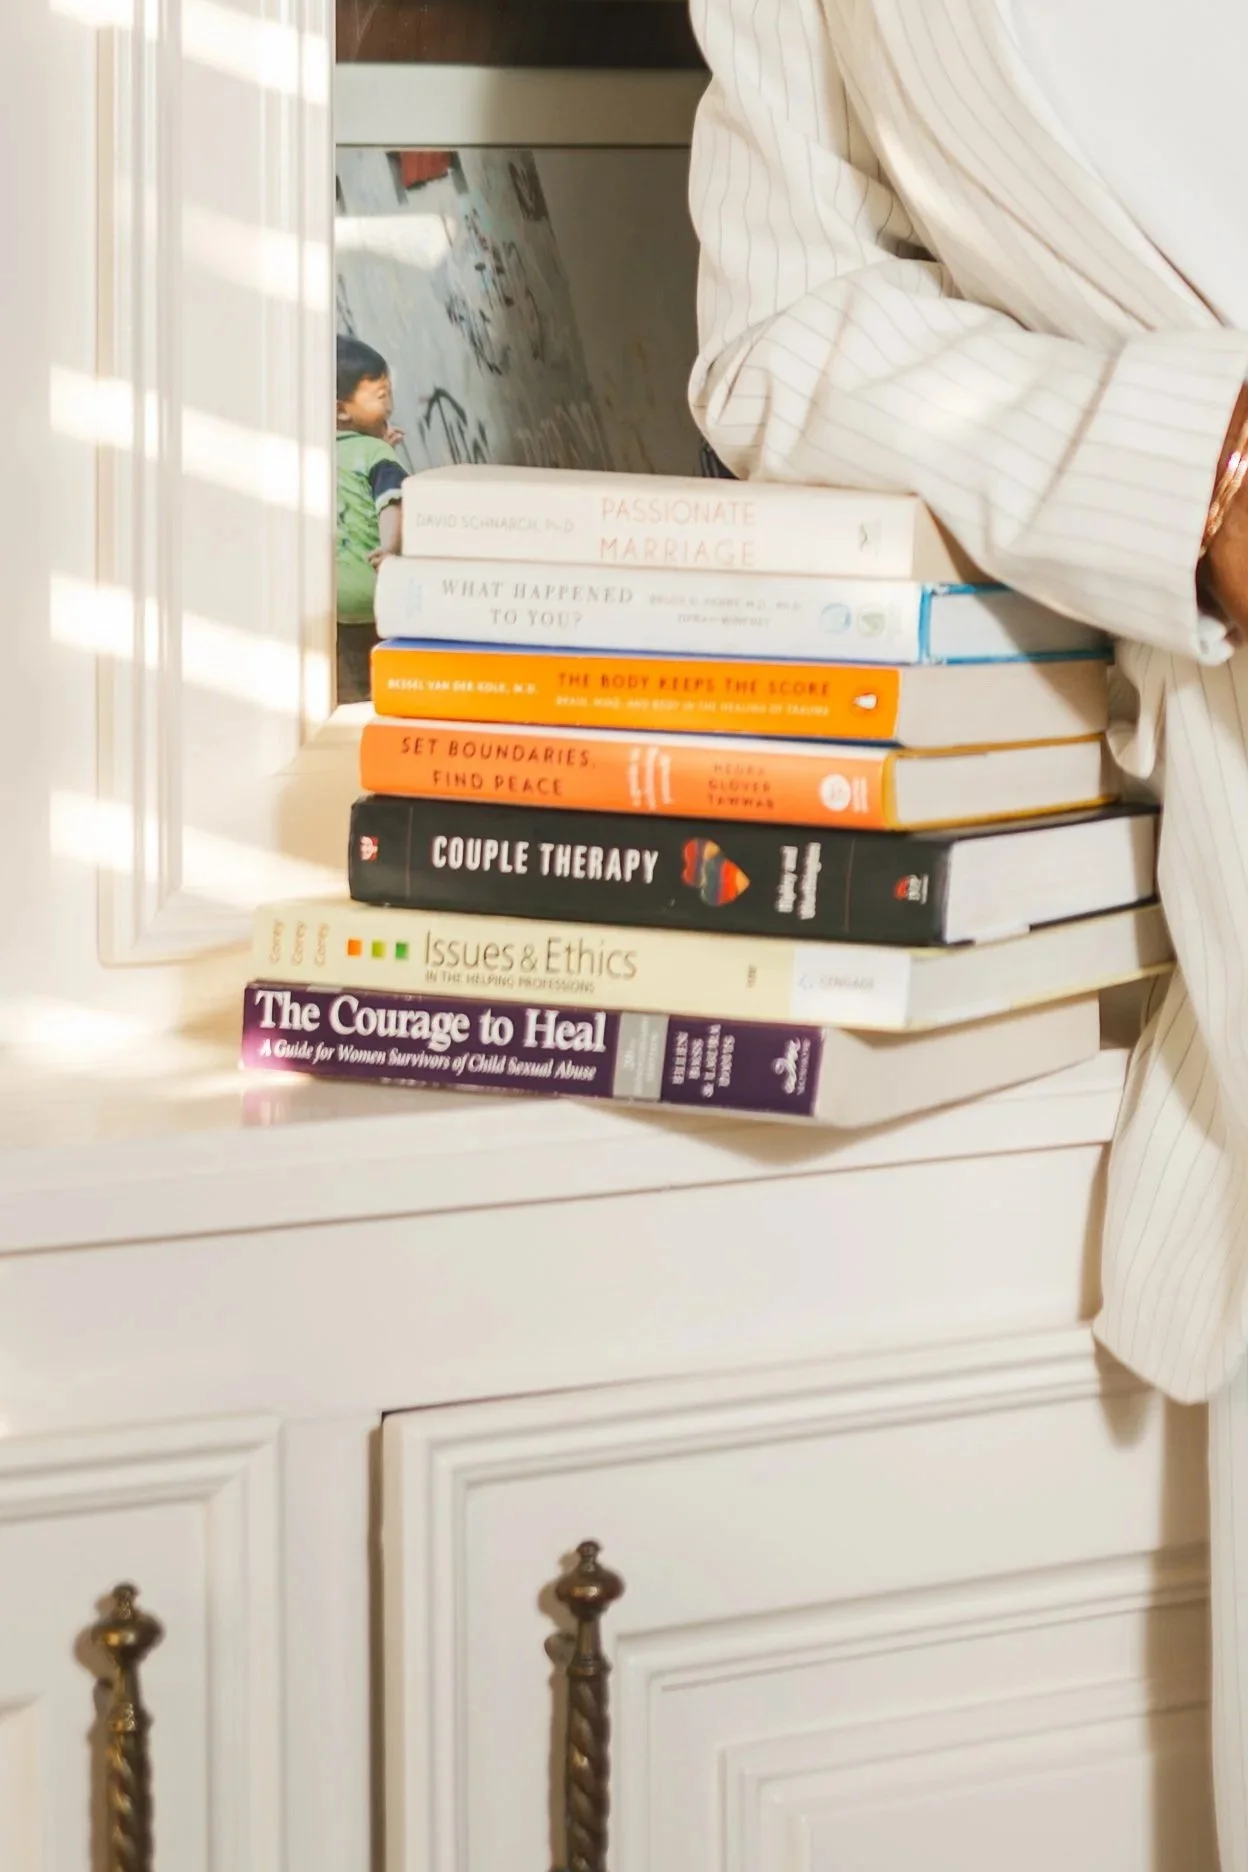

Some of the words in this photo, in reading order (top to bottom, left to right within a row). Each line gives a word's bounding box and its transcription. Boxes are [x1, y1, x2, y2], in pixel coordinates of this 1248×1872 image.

[416, 513, 456, 529] DAVID
[602, 496, 757, 527] PASSIONATE
[600, 537, 757, 568] MARRIAGE
[442, 578, 504, 599] WHAT
[512, 582, 634, 605] HAPPENED
[490, 607, 519, 626] TO
[526, 609, 583, 629] YOU?
[558, 672, 588, 689] THE
[599, 673, 649, 690] BODY
[658, 676, 716, 693] KEEPS
[724, 677, 757, 695] THE
[767, 679, 829, 697] SCORE
[401, 736, 438, 756] SET
[432, 769, 483, 790] FIND
[493, 775, 562, 797] PEACE
[431, 835, 529, 875] COUPLE
[539, 842, 659, 885] THERAPY
[267, 917, 286, 966] Corey
[290, 919, 309, 967] Corey
[313, 922, 332, 969] Corey
[426, 929, 515, 972] Issues
[519, 943, 538, 974] &
[546, 936, 638, 980] Ethics
[426, 969, 440, 983] IN
[442, 970, 462, 985] THE
[466, 974, 515, 989] HELPING
[254, 989, 321, 1032] The
[328, 994, 471, 1053] Courage
[479, 1008, 514, 1047] to
[523, 1007, 606, 1053] Heal
[259, 1038, 272, 1058] A
[273, 1039, 314, 1059] Guide
[311, 1041, 336, 1066] for
[337, 1044, 387, 1066] Women
[387, 1046, 452, 1071] Survivors
[450, 1051, 470, 1077] of
[467, 1052, 508, 1074] Child
[505, 1055, 555, 1079] Sexual
[553, 1059, 598, 1082] Abuse
